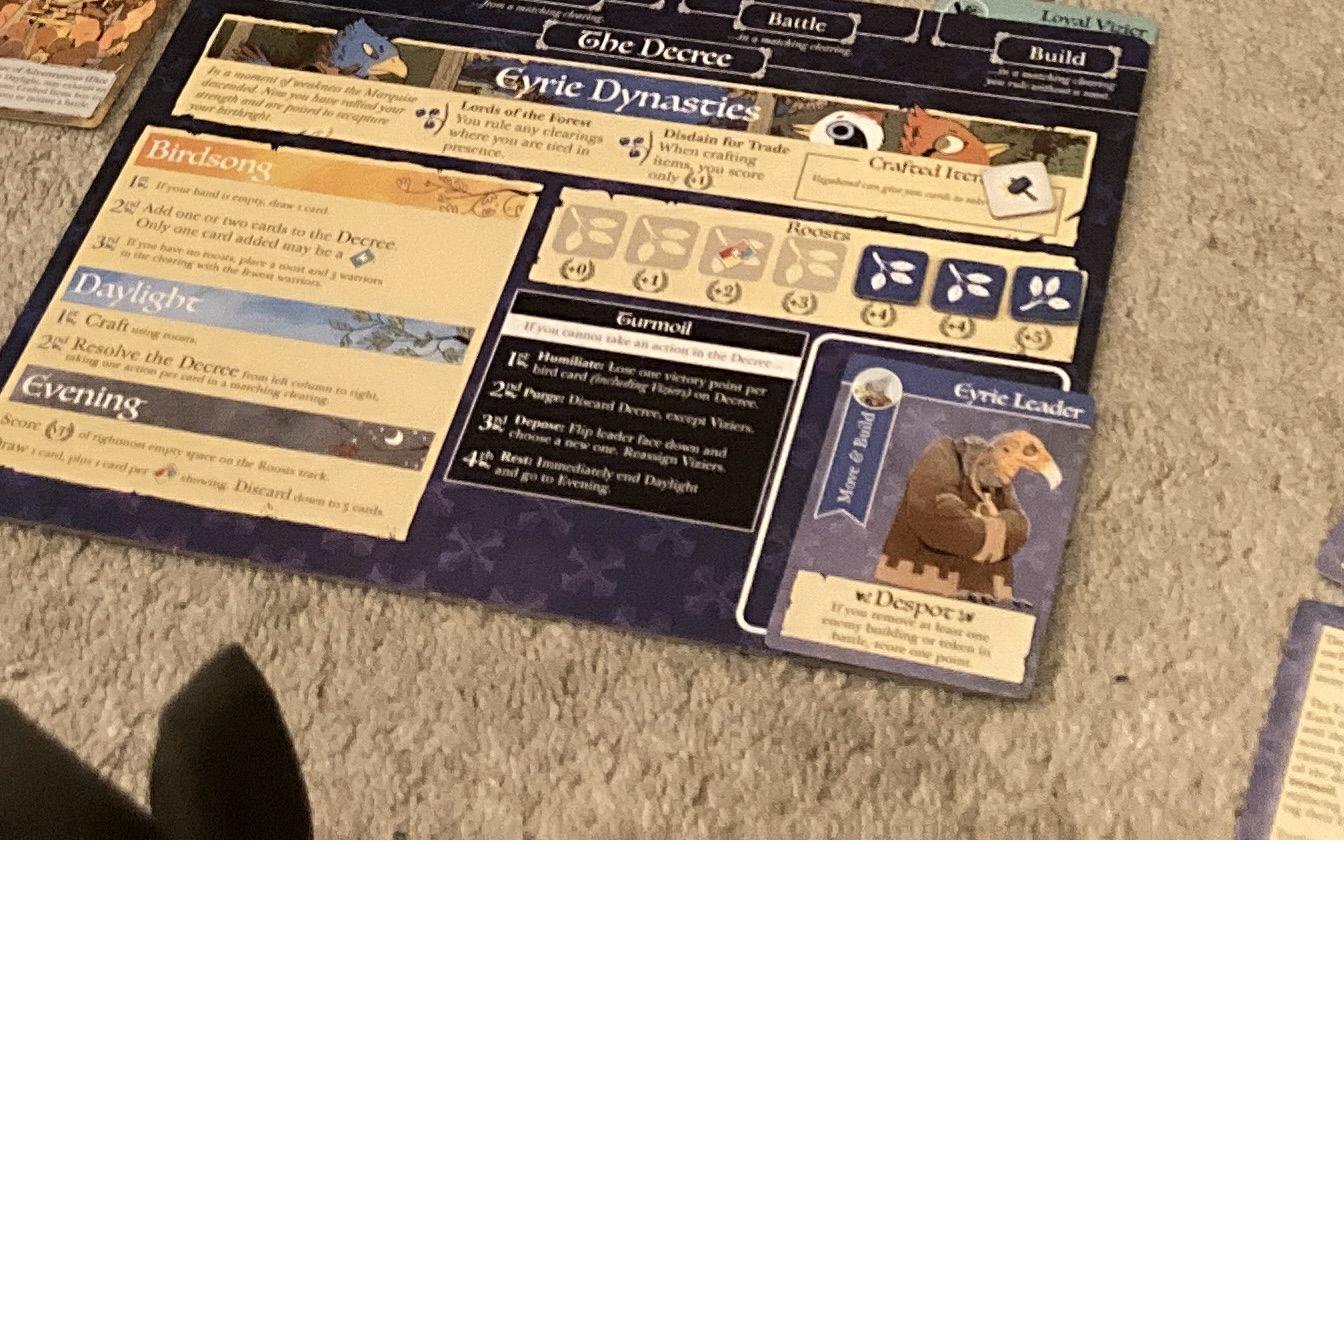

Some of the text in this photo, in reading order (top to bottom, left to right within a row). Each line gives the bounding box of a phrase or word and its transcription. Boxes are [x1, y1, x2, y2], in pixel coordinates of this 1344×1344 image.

[768, 11, 826, 32] Battle
[1041, 9, 1149, 38] Loyal Vizier
[577, 29, 731, 67] The Decree
[1029, 45, 1086, 66] Build
[494, 67, 762, 122] Eyrie Dynasties
[460, 100, 591, 127] Lords of the Forest
[449, 128, 590, 156] where you are tied in
[456, 113, 603, 144] You rule any clearings
[663, 128, 789, 154] Disdain for Trade
[147, 138, 273, 182] Birdsong
[441, 143, 501, 157] presence.
[659, 141, 757, 167] When crafting
[647, 171, 679, 182] only
[652, 155, 764, 180] items, you score
[868, 156, 941, 177] Crafted
[144, 202, 173, 216] Add
[174, 210, 201, 221] one
[203, 214, 219, 224] or
[221, 216, 248, 228] two
[250, 222, 287, 234] cards
[290, 226, 306, 237] to
[308, 228, 332, 241] the
[786, 220, 850, 241] Roosts
[135, 217, 343, 259] Only one card added may be a
[74, 273, 202, 313] Daylight
[84, 313, 129, 332] Craft
[616, 311, 692, 335] Turmoil
[71, 336, 140, 360] Resolve
[144, 350, 173, 365] the
[178, 355, 239, 377] Decree
[22, 374, 146, 420] Evening
[953, 383, 1084, 418] Eyrie Leader
[0, 413, 41, 430] Score
[836, 459, 860, 503] Move
[852, 410, 875, 448] Build
[233, 479, 292, 500] Discard
[875, 590, 954, 619] Despot
